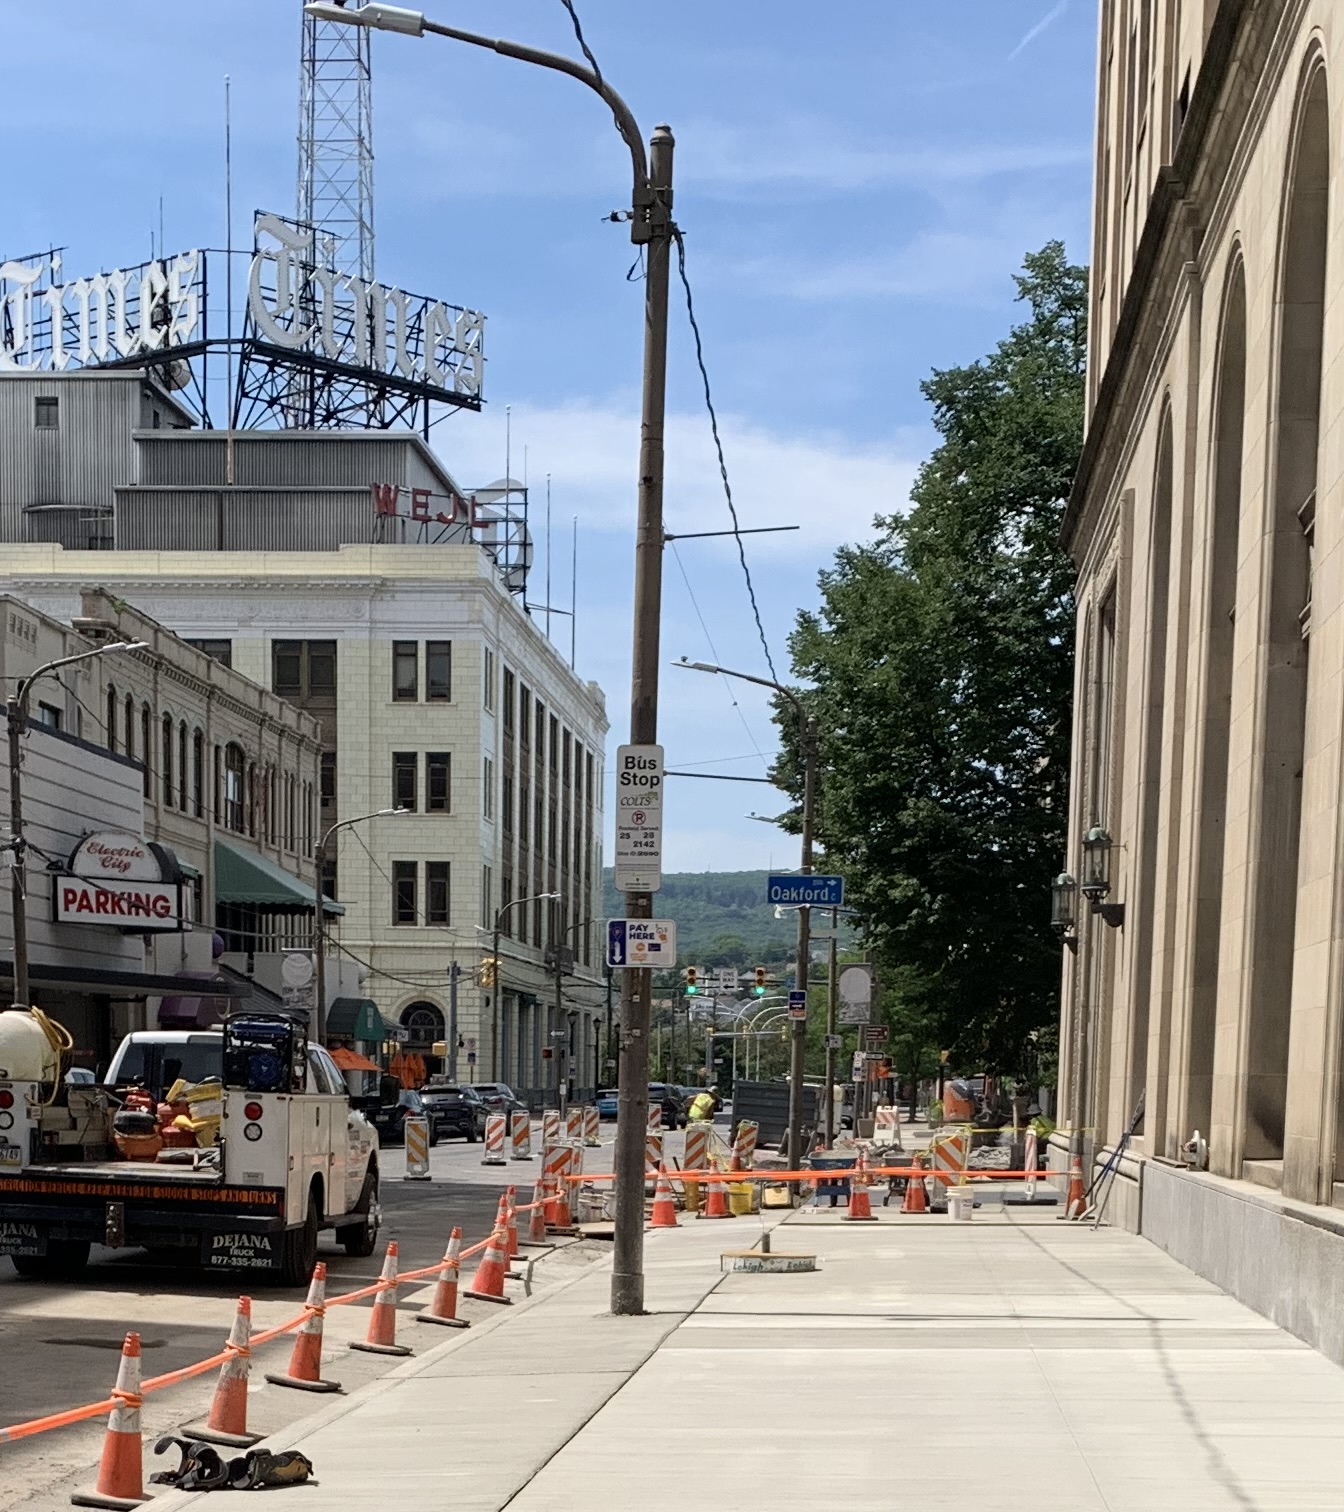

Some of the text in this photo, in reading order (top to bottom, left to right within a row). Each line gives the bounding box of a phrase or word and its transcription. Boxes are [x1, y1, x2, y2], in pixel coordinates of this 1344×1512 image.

[249, 214, 485, 396] Times
[371, 482, 490, 528] WEJL
[624, 755, 657, 770] Bus
[620, 771, 660, 789] Stop
[620, 796, 651, 807] COLTS
[86, 841, 145, 858] Electric
[633, 840, 655, 848] 2142
[771, 885, 829, 901] Oakford
[62, 887, 171, 919] PARKING
[629, 924, 649, 932] PAY
[629, 932, 655, 940] HERE
[212, 1233, 272, 1250] DEJANA
[229, 1248, 255, 1257] TRUCK
